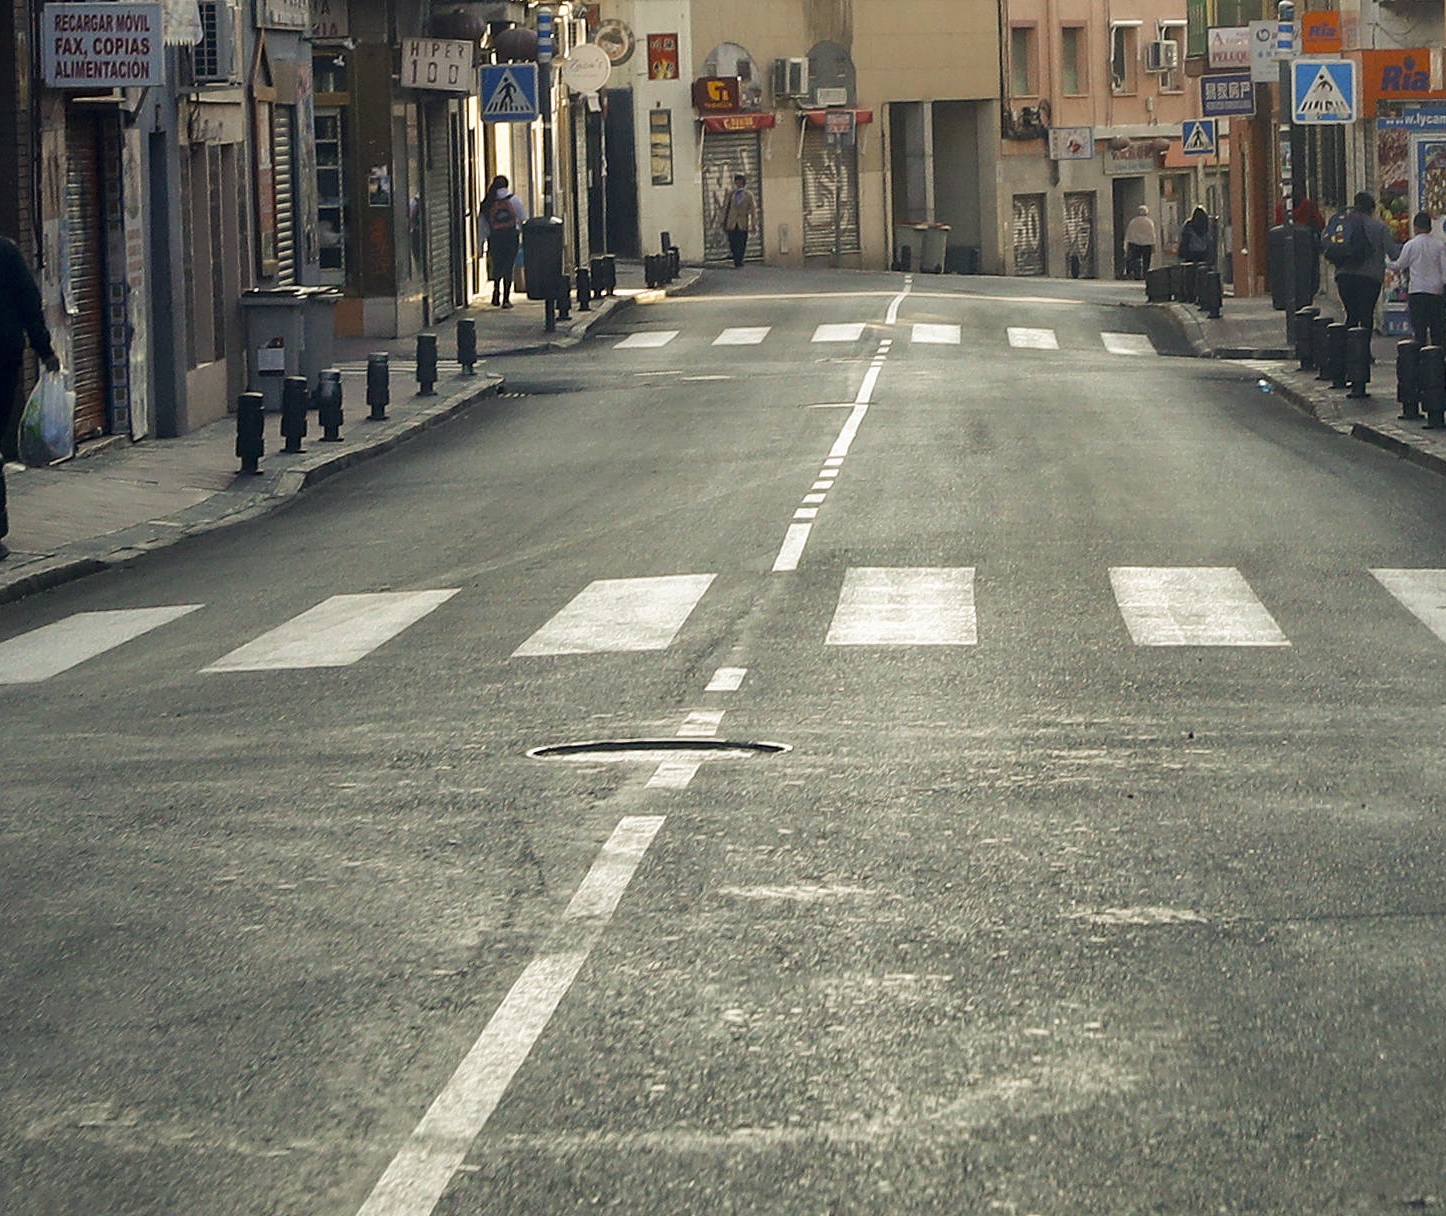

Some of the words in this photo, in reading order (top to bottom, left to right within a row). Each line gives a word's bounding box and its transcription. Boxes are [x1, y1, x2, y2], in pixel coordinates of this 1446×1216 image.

[55, 14, 113, 32] RECARGAR
[55, 38, 87, 57] FAX,
[93, 38, 150, 55] COPIAS
[411, 41, 464, 59] HIPER
[411, 60, 459, 84] 100
[1381, 55, 1430, 91] Ria
